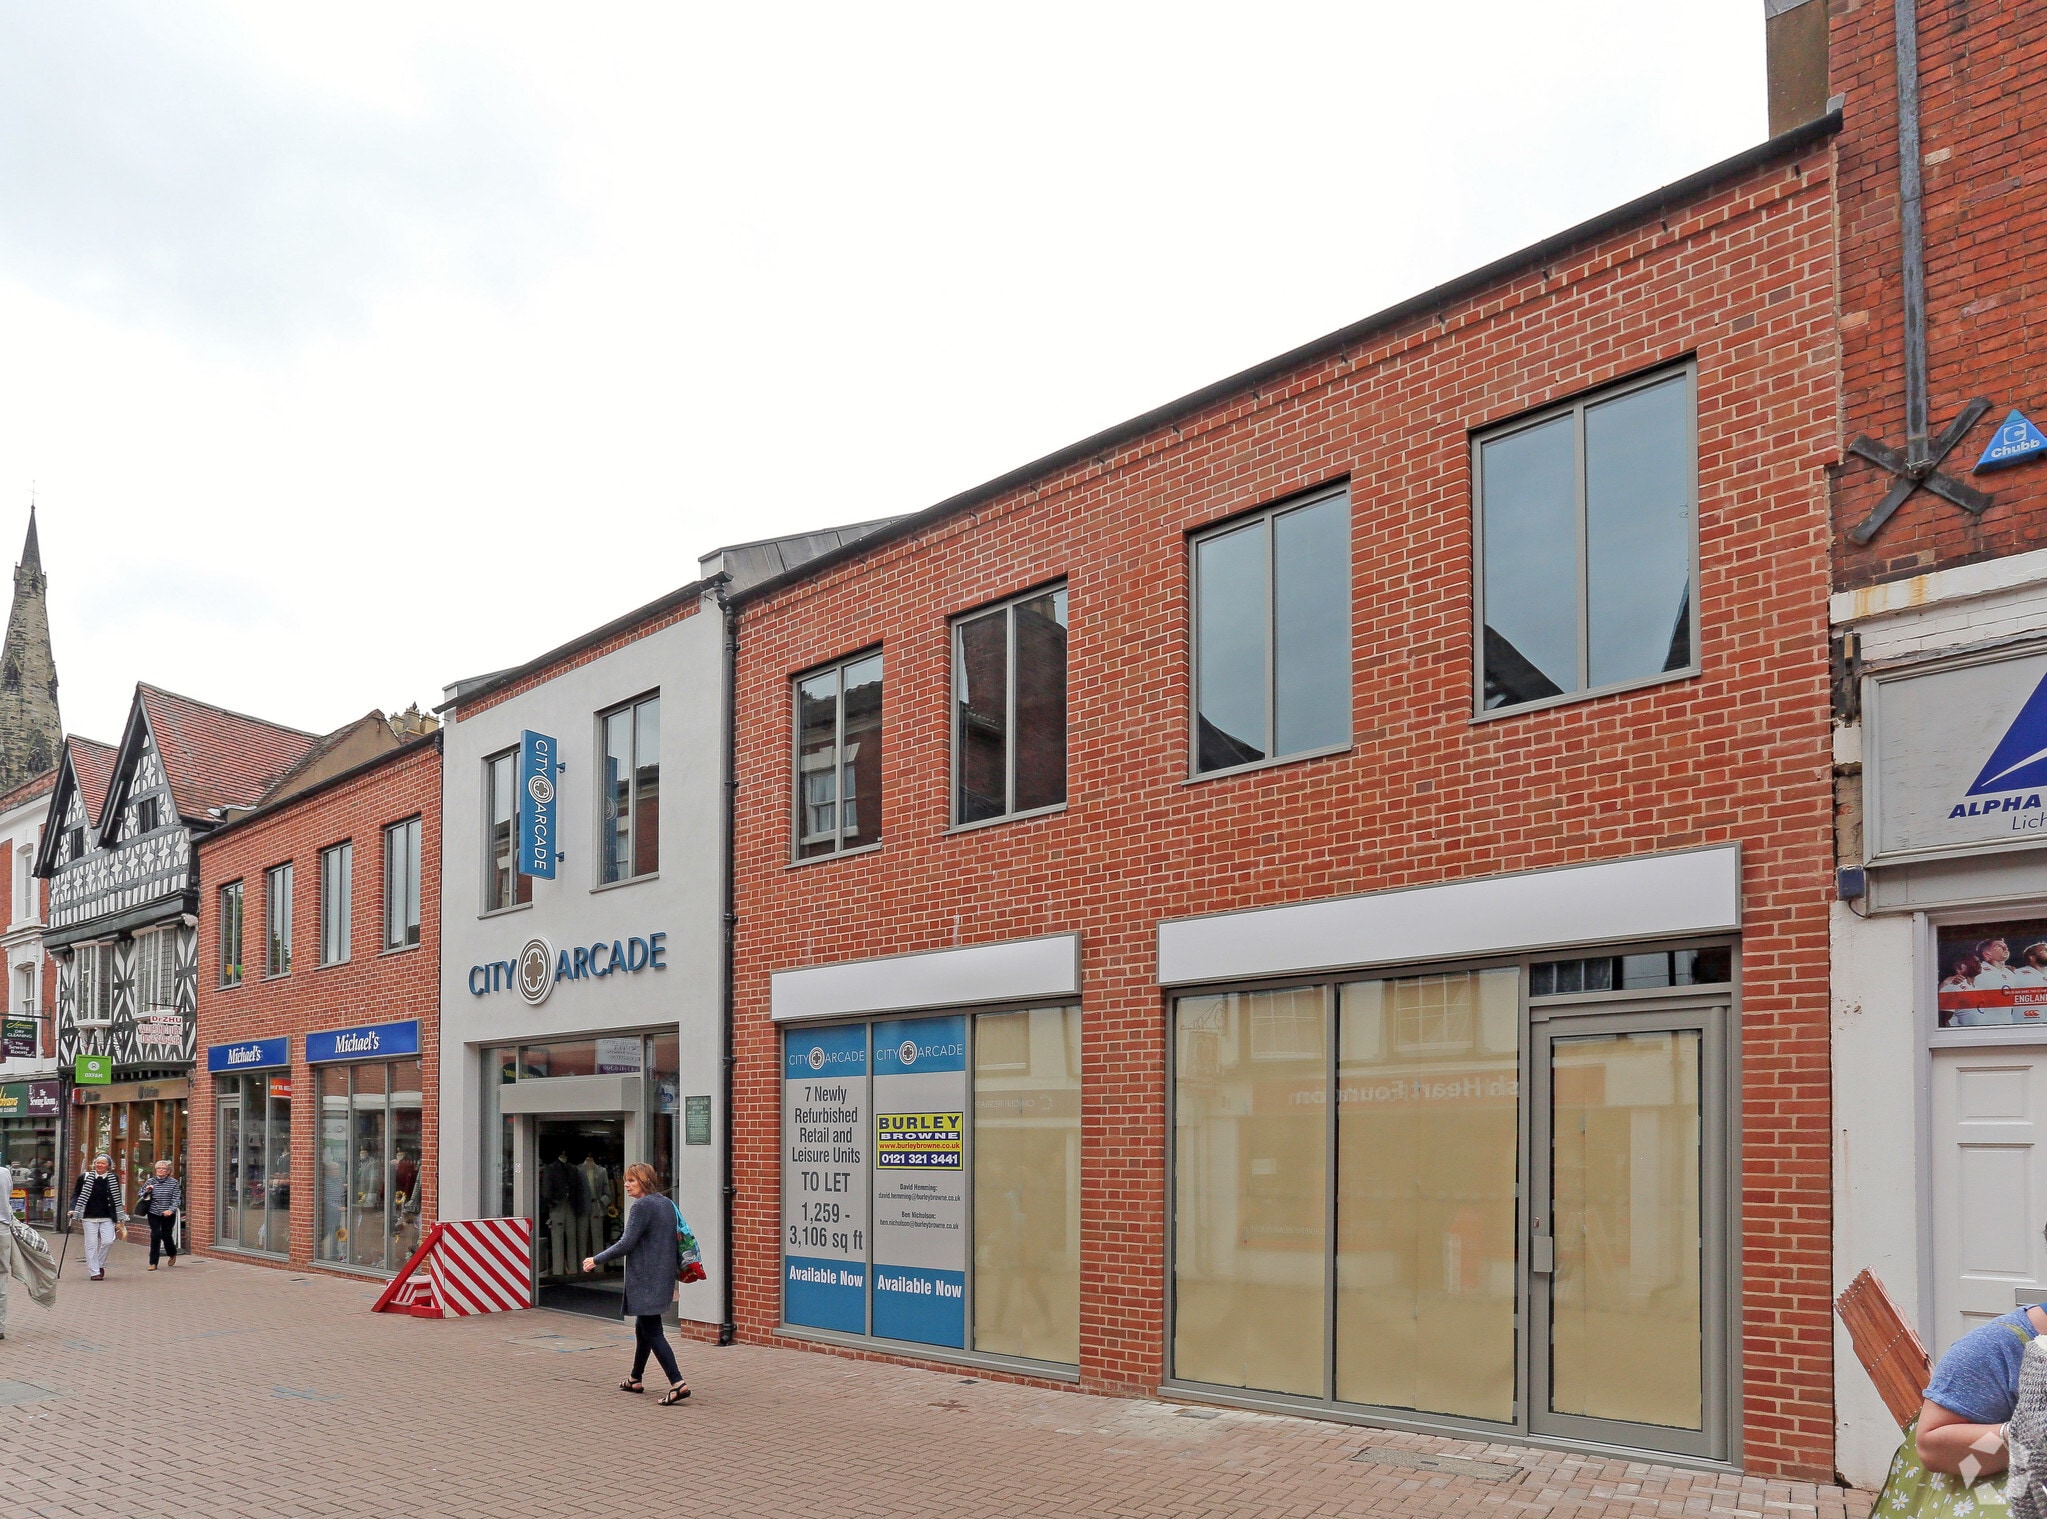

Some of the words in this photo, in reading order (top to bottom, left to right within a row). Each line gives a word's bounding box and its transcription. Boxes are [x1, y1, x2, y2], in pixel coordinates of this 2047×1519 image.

[1991, 439, 2040, 458] Chubb
[535, 739, 548, 777] CITY
[1947, 794, 2041, 819] ALPHA
[534, 802, 547, 870] ARCADE
[469, 959, 517, 996] CITY
[555, 932, 667, 982] ARCADE
[2014, 994, 2047, 1003] ENGLAN
[334, 1030, 380, 1054] Michael's
[227, 1045, 262, 1065] Michael's
[789, 1054, 809, 1066] CITY
[824, 1051, 865, 1064] ARCADE
[876, 1049, 900, 1061] CITY
[917, 1044, 963, 1058] ARCADE
[804, 1086, 811, 1102] 7
[814, 1085, 847, 1104] Newly
[795, 1107, 858, 1124] Refurbished
[879, 1115, 960, 1130] BURLEY
[800, 1127, 829, 1143] Retail
[833, 1127, 852, 1143] and
[880, 1132, 958, 1140] BROWNE
[879, 1142, 960, 1150] www.burleybrowne.co.uk
[792, 1147, 830, 1163] Leisure
[833, 1147, 860, 1164] Units
[881, 1154, 905, 1164] 0121
[908, 1154, 927, 1164] 321
[930, 1154, 958, 1164] 3441
[801, 1171, 820, 1192] TO
[824, 1172, 850, 1193] LET
[914, 1184, 938, 1192] Hemming:
[878, 1192, 961, 1201] david.hemming@burleybrowne.co.uk
[801, 1202, 840, 1225] 1,259
[912, 1211, 936, 1219] Nicholson:
[880, 1219, 959, 1229] ben.nicholson@burleybrowne.co.uk
[789, 1226, 827, 1248] 3,106
[832, 1232, 848, 1253] sq
[853, 1230, 863, 1250] ft
[789, 1265, 837, 1285] Available
[840, 1270, 863, 1288] Now
[877, 1274, 932, 1295] Available
[935, 1279, 962, 1298] Now
